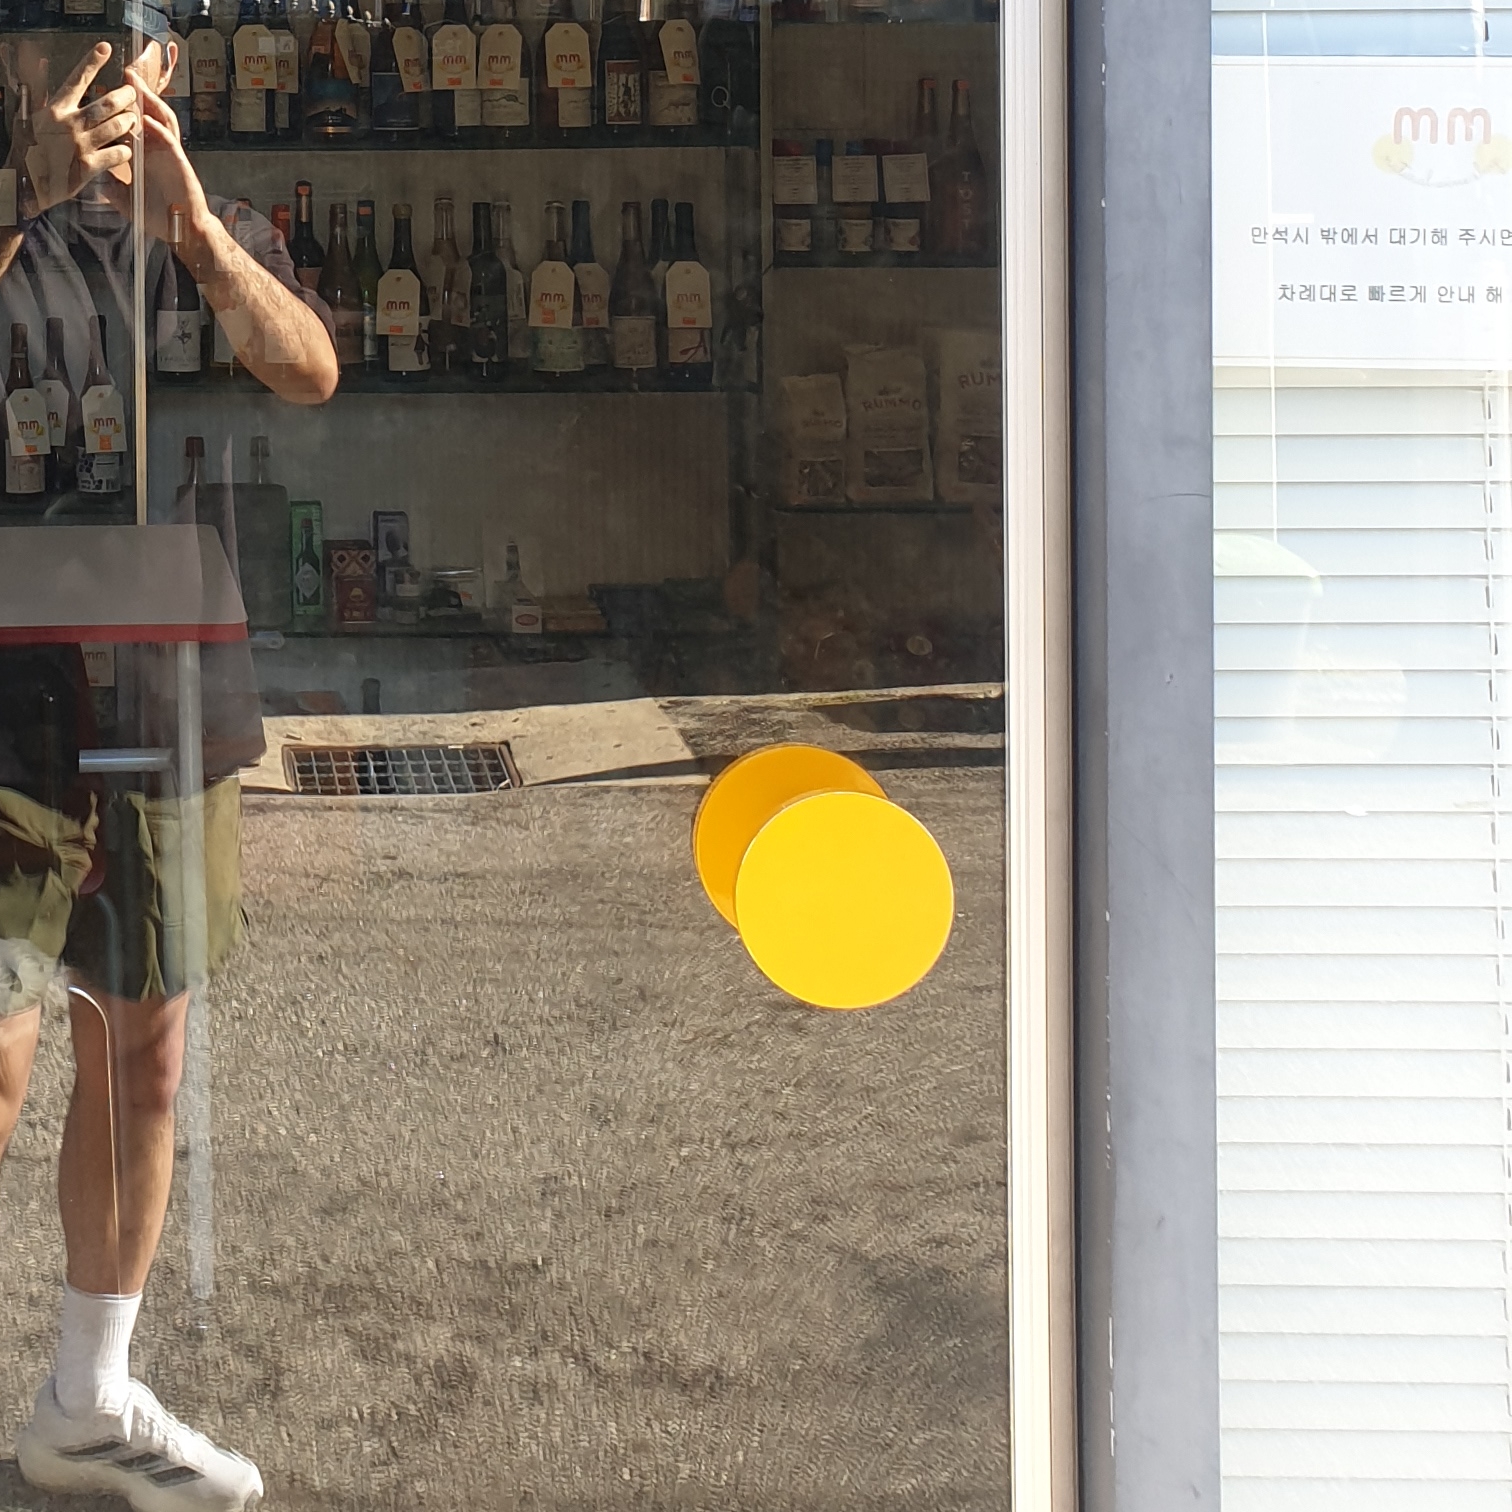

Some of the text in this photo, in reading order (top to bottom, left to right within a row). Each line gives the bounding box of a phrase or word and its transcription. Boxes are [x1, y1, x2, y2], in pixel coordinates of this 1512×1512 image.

[244, 55, 267, 65] mm
[488, 55, 512, 65] mm
[556, 53, 581, 64] mm
[1393, 106, 1492, 145] mm
[1250, 226, 1309, 246] 만석시
[1320, 226, 1379, 246] 밖에서
[1389, 227, 1448, 247] 대기해
[540, 292, 564, 303] mm
[1278, 284, 1503, 304] 차례대로 빠르게 안내 해
[386, 300, 410, 311] mm
[93, 417, 117, 428] mm
